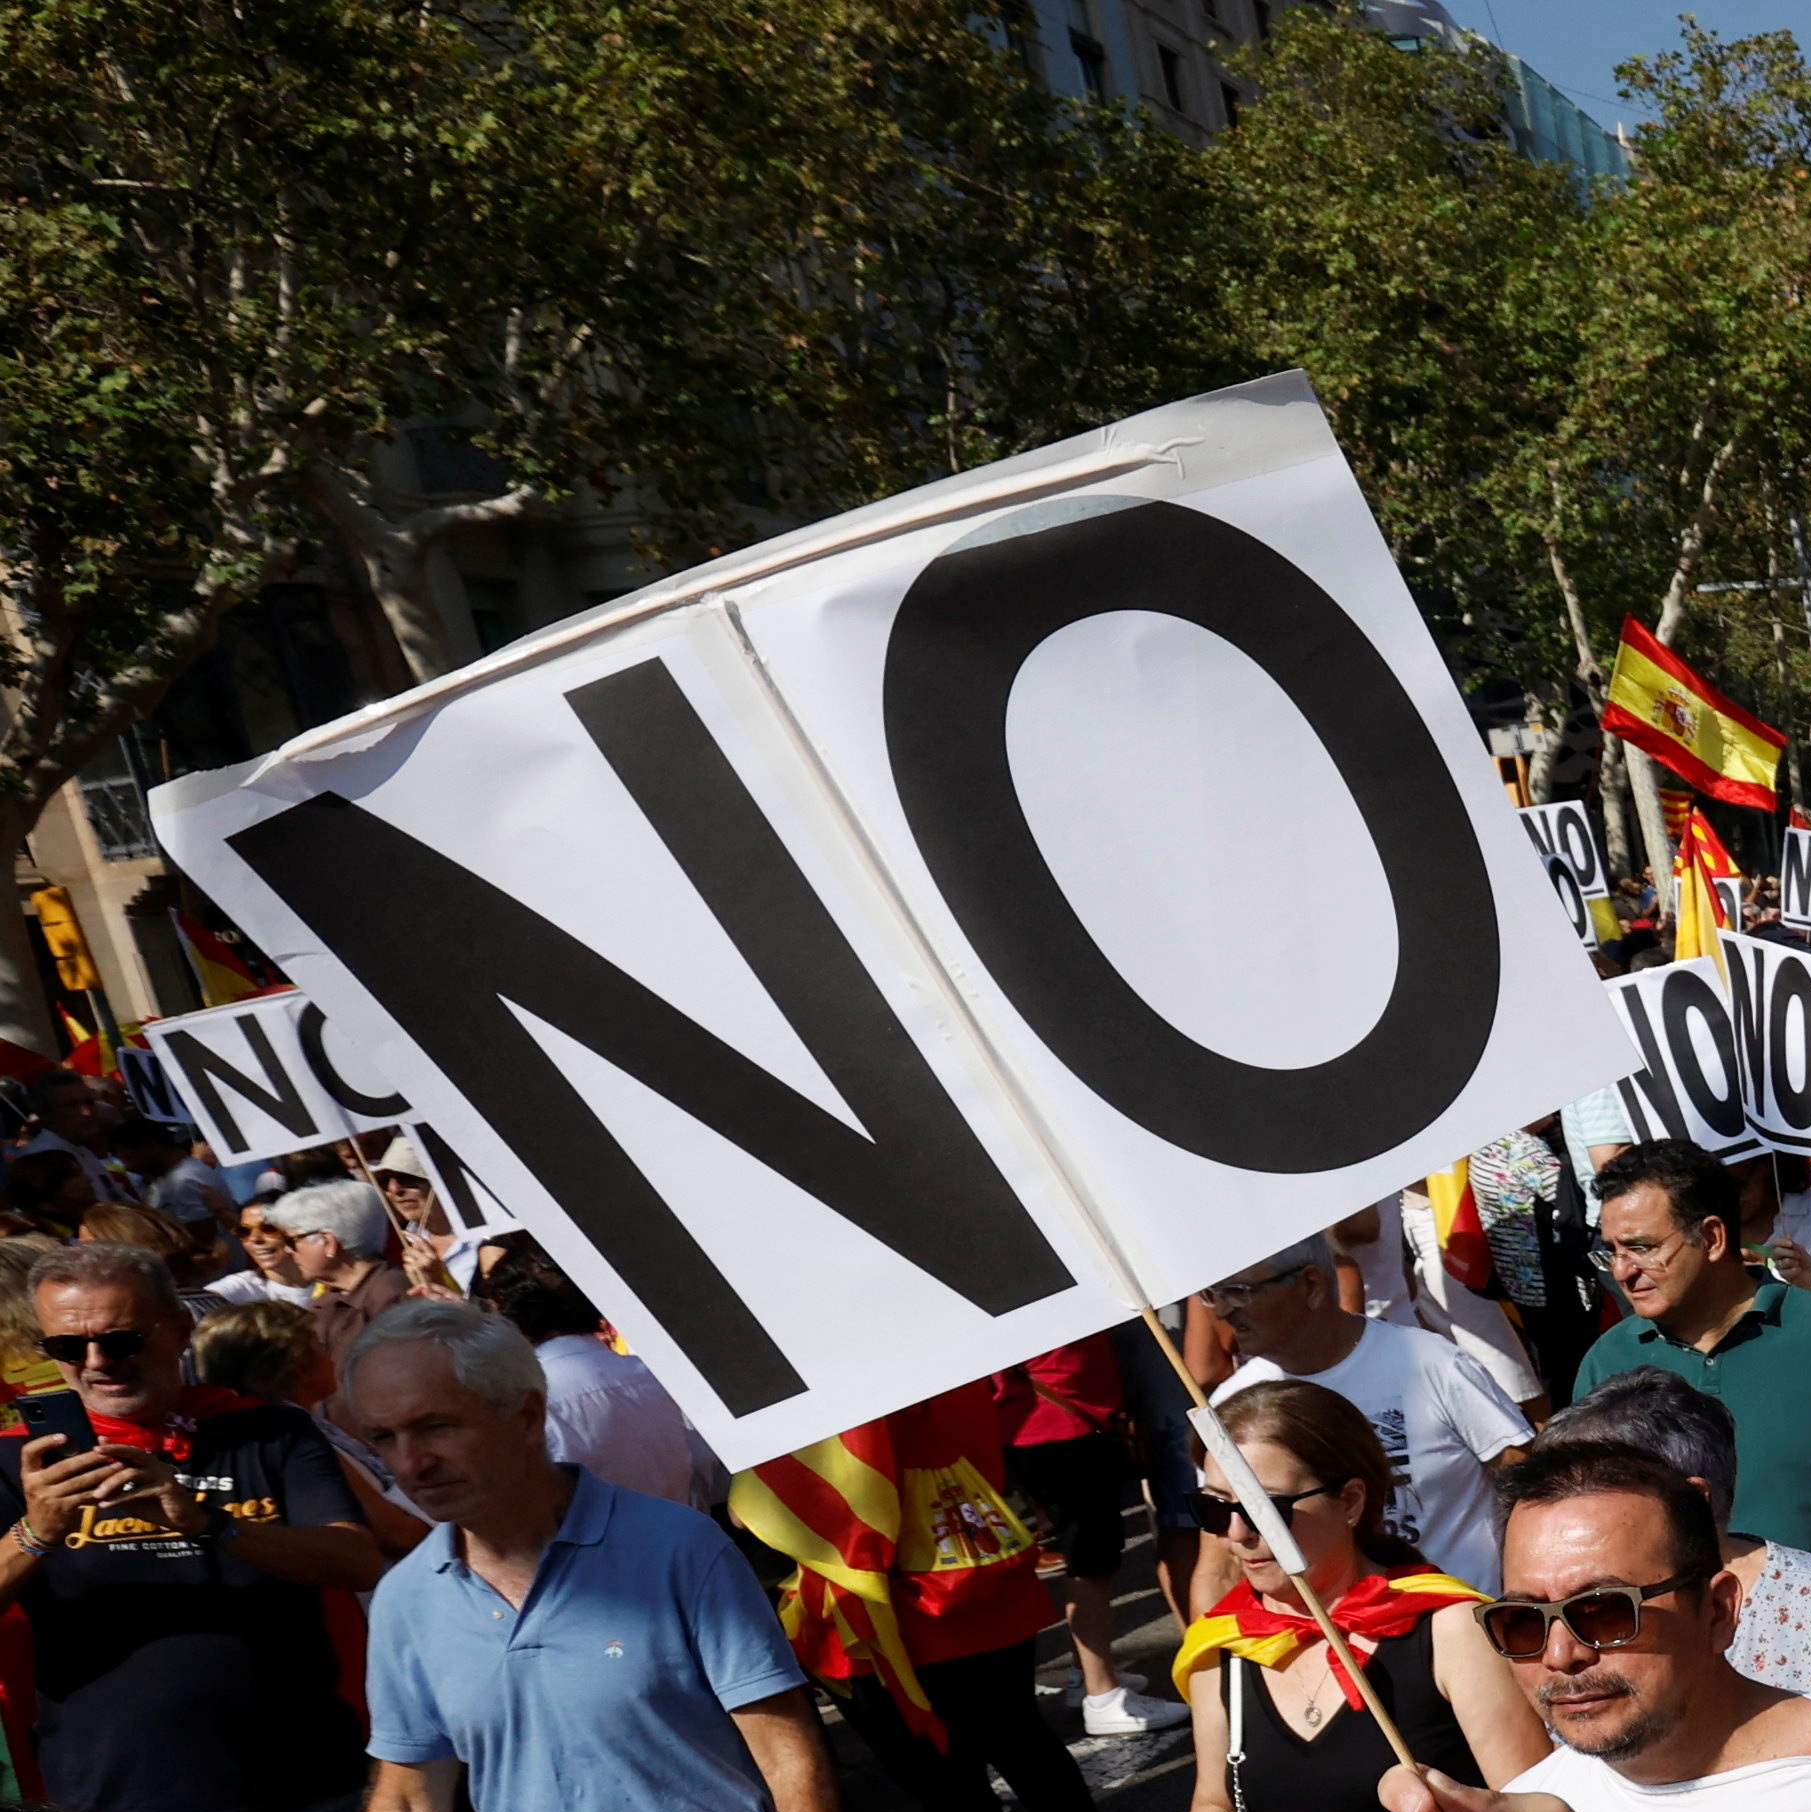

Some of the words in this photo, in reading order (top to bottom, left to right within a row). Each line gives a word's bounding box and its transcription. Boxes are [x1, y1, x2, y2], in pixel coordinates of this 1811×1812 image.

[1520, 805, 1596, 887] NO
[225, 498, 1500, 1418] NO
[1617, 968, 1745, 1145] NO
